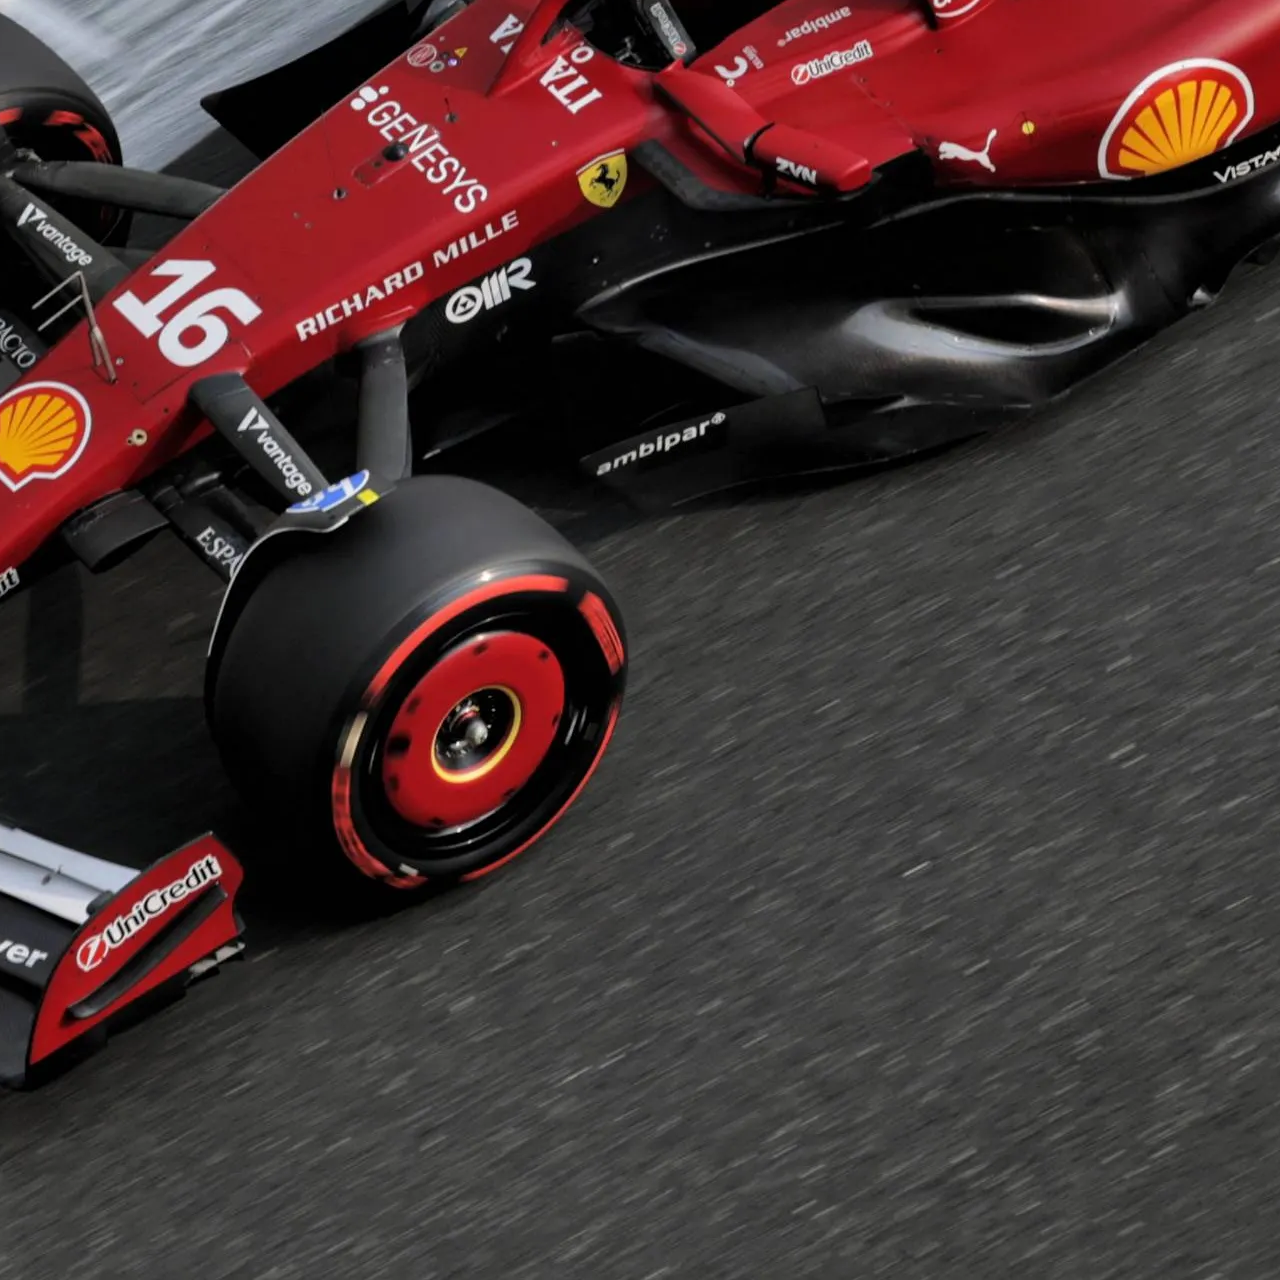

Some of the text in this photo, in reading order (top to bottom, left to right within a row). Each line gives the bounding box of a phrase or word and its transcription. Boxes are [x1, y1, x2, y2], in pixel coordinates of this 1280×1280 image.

[808, 39, 874, 78] UniCredit
[367, 99, 488, 214] GENESYS
[112, 260, 261, 366] 16
[296, 210, 519, 342] RICHARD MILLE
[104, 855, 222, 954] UniCredit
